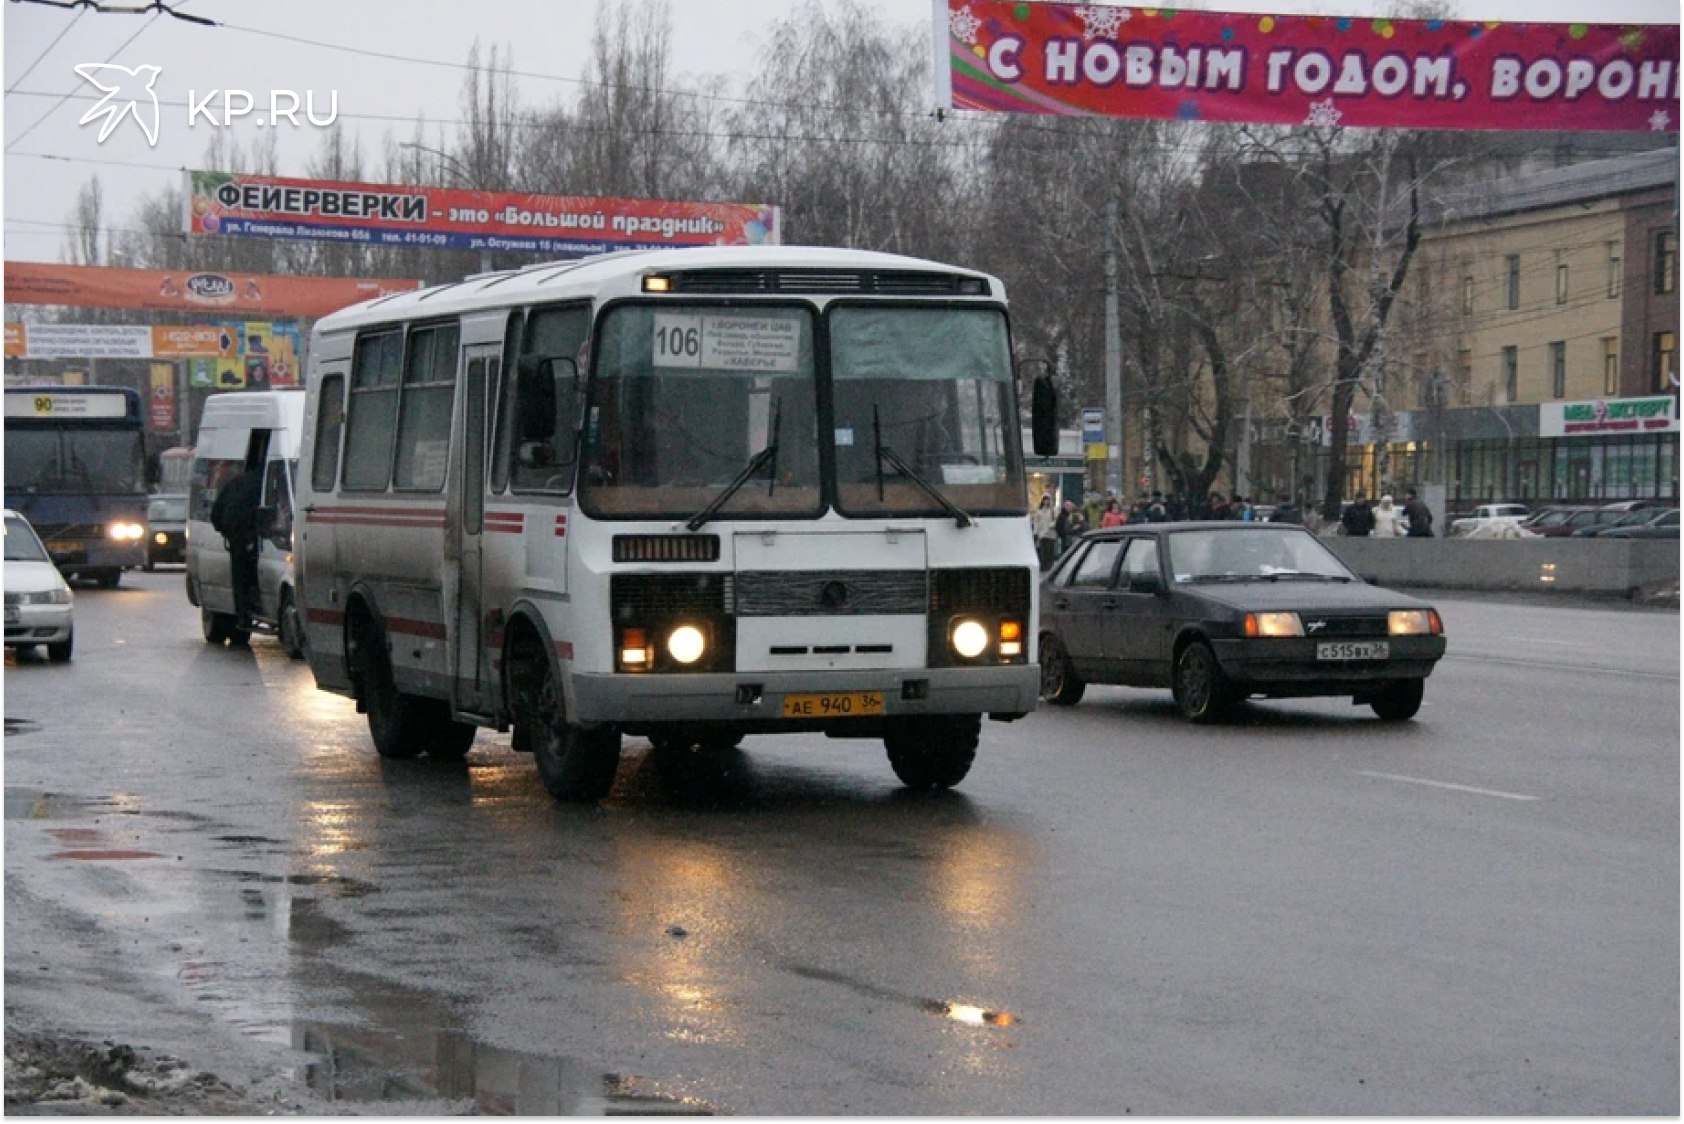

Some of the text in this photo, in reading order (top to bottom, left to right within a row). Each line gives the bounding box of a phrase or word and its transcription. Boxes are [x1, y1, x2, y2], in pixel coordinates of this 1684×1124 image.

[989, 37, 1680, 99] С НОВЫМ ГОДОМ, ВОРОН
[449, 206, 489, 223] это
[495, 206, 605, 229] «Большой
[612, 213, 724, 237] праздник»
[656, 326, 699, 356] 106
[34, 397, 51, 411] 90
[793, 700, 812, 715] АЕ
[821, 696, 852, 713] 940
